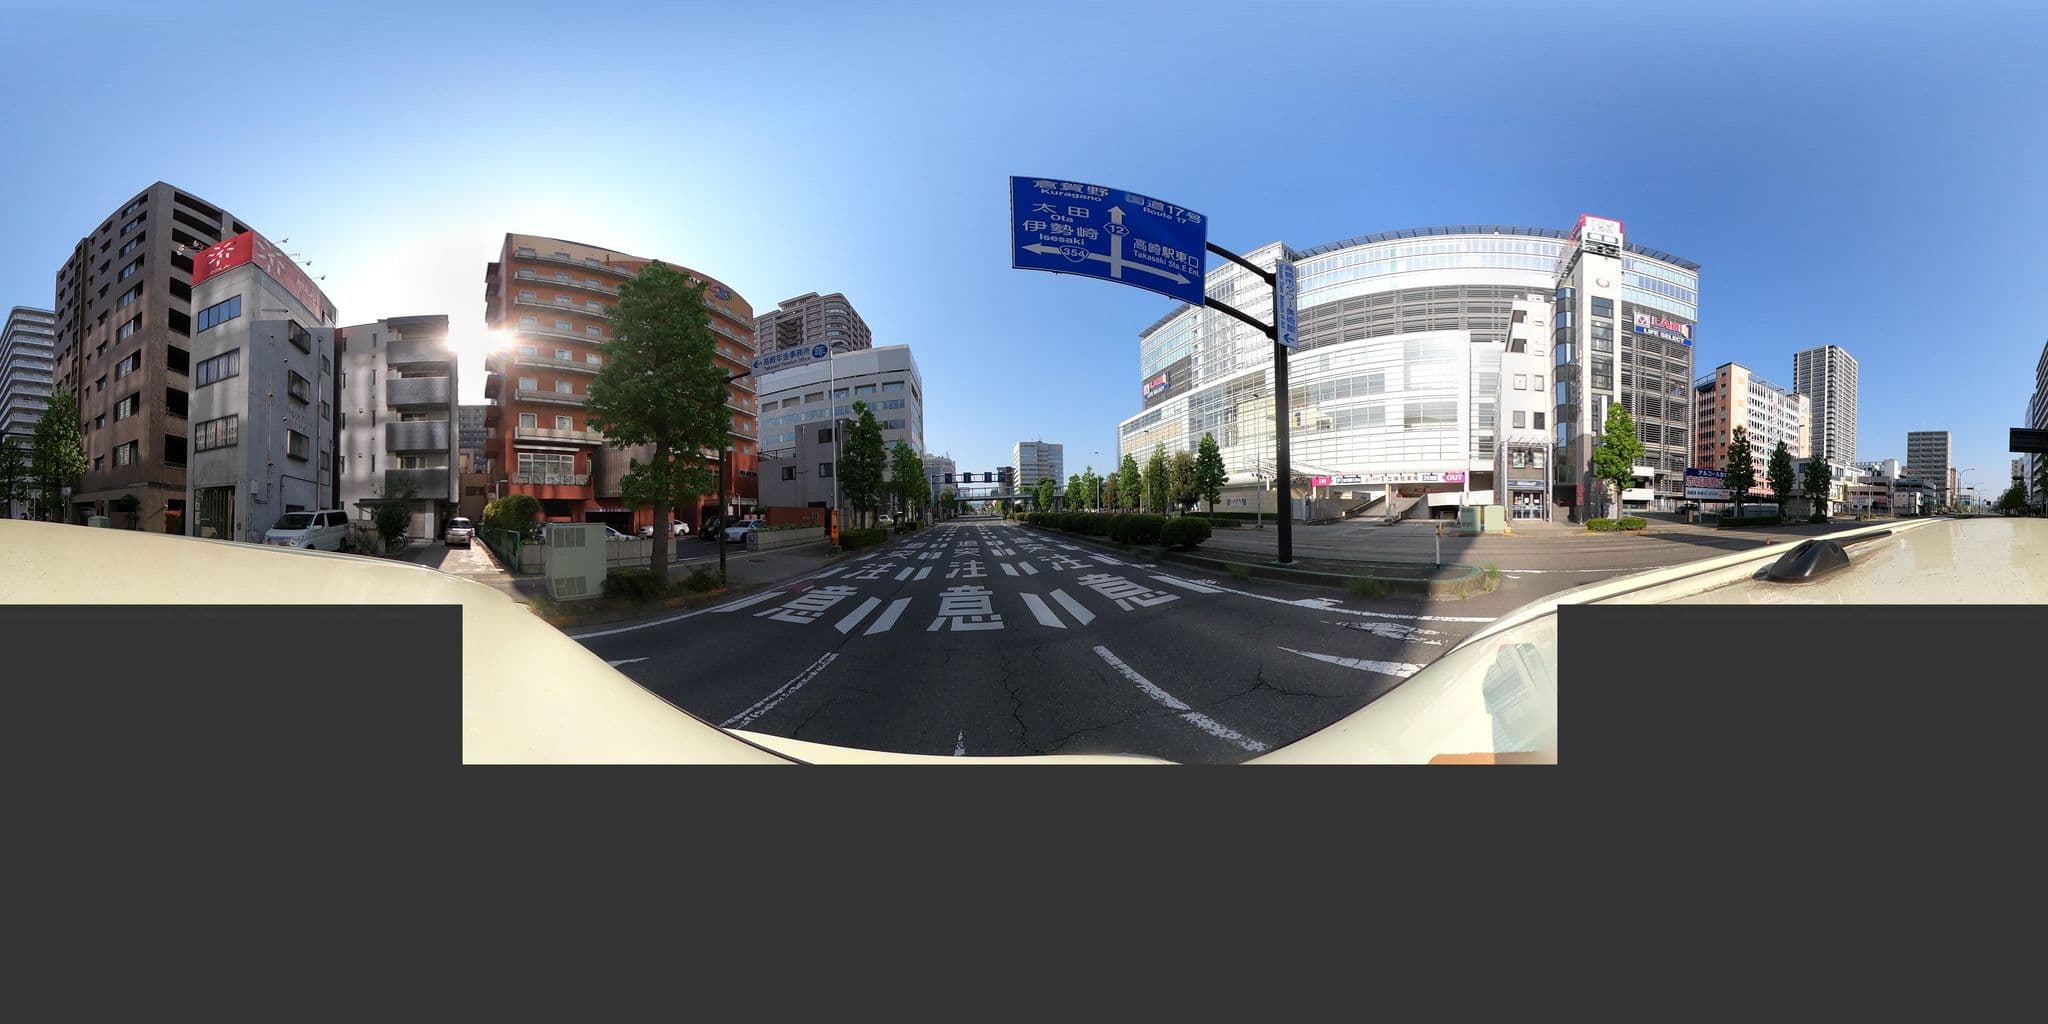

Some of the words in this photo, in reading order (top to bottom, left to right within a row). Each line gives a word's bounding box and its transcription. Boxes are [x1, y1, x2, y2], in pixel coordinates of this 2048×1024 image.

[1041, 188, 1102, 202] Kuragano
[1032, 203, 1090, 218] 太田
[1143, 206, 1173, 220] Route
[1050, 214, 1074, 223] Ota
[1022, 220, 1099, 240] 伊勢崎
[1109, 225, 1125, 235] 12
[1040, 233, 1085, 246] Isesaki
[1063, 247, 1086, 258] 354
[1133, 238, 1199, 269] 高崎駅東口
[1133, 249, 1167, 265] Takasaki
[1446, 474, 1463, 482] OUT
